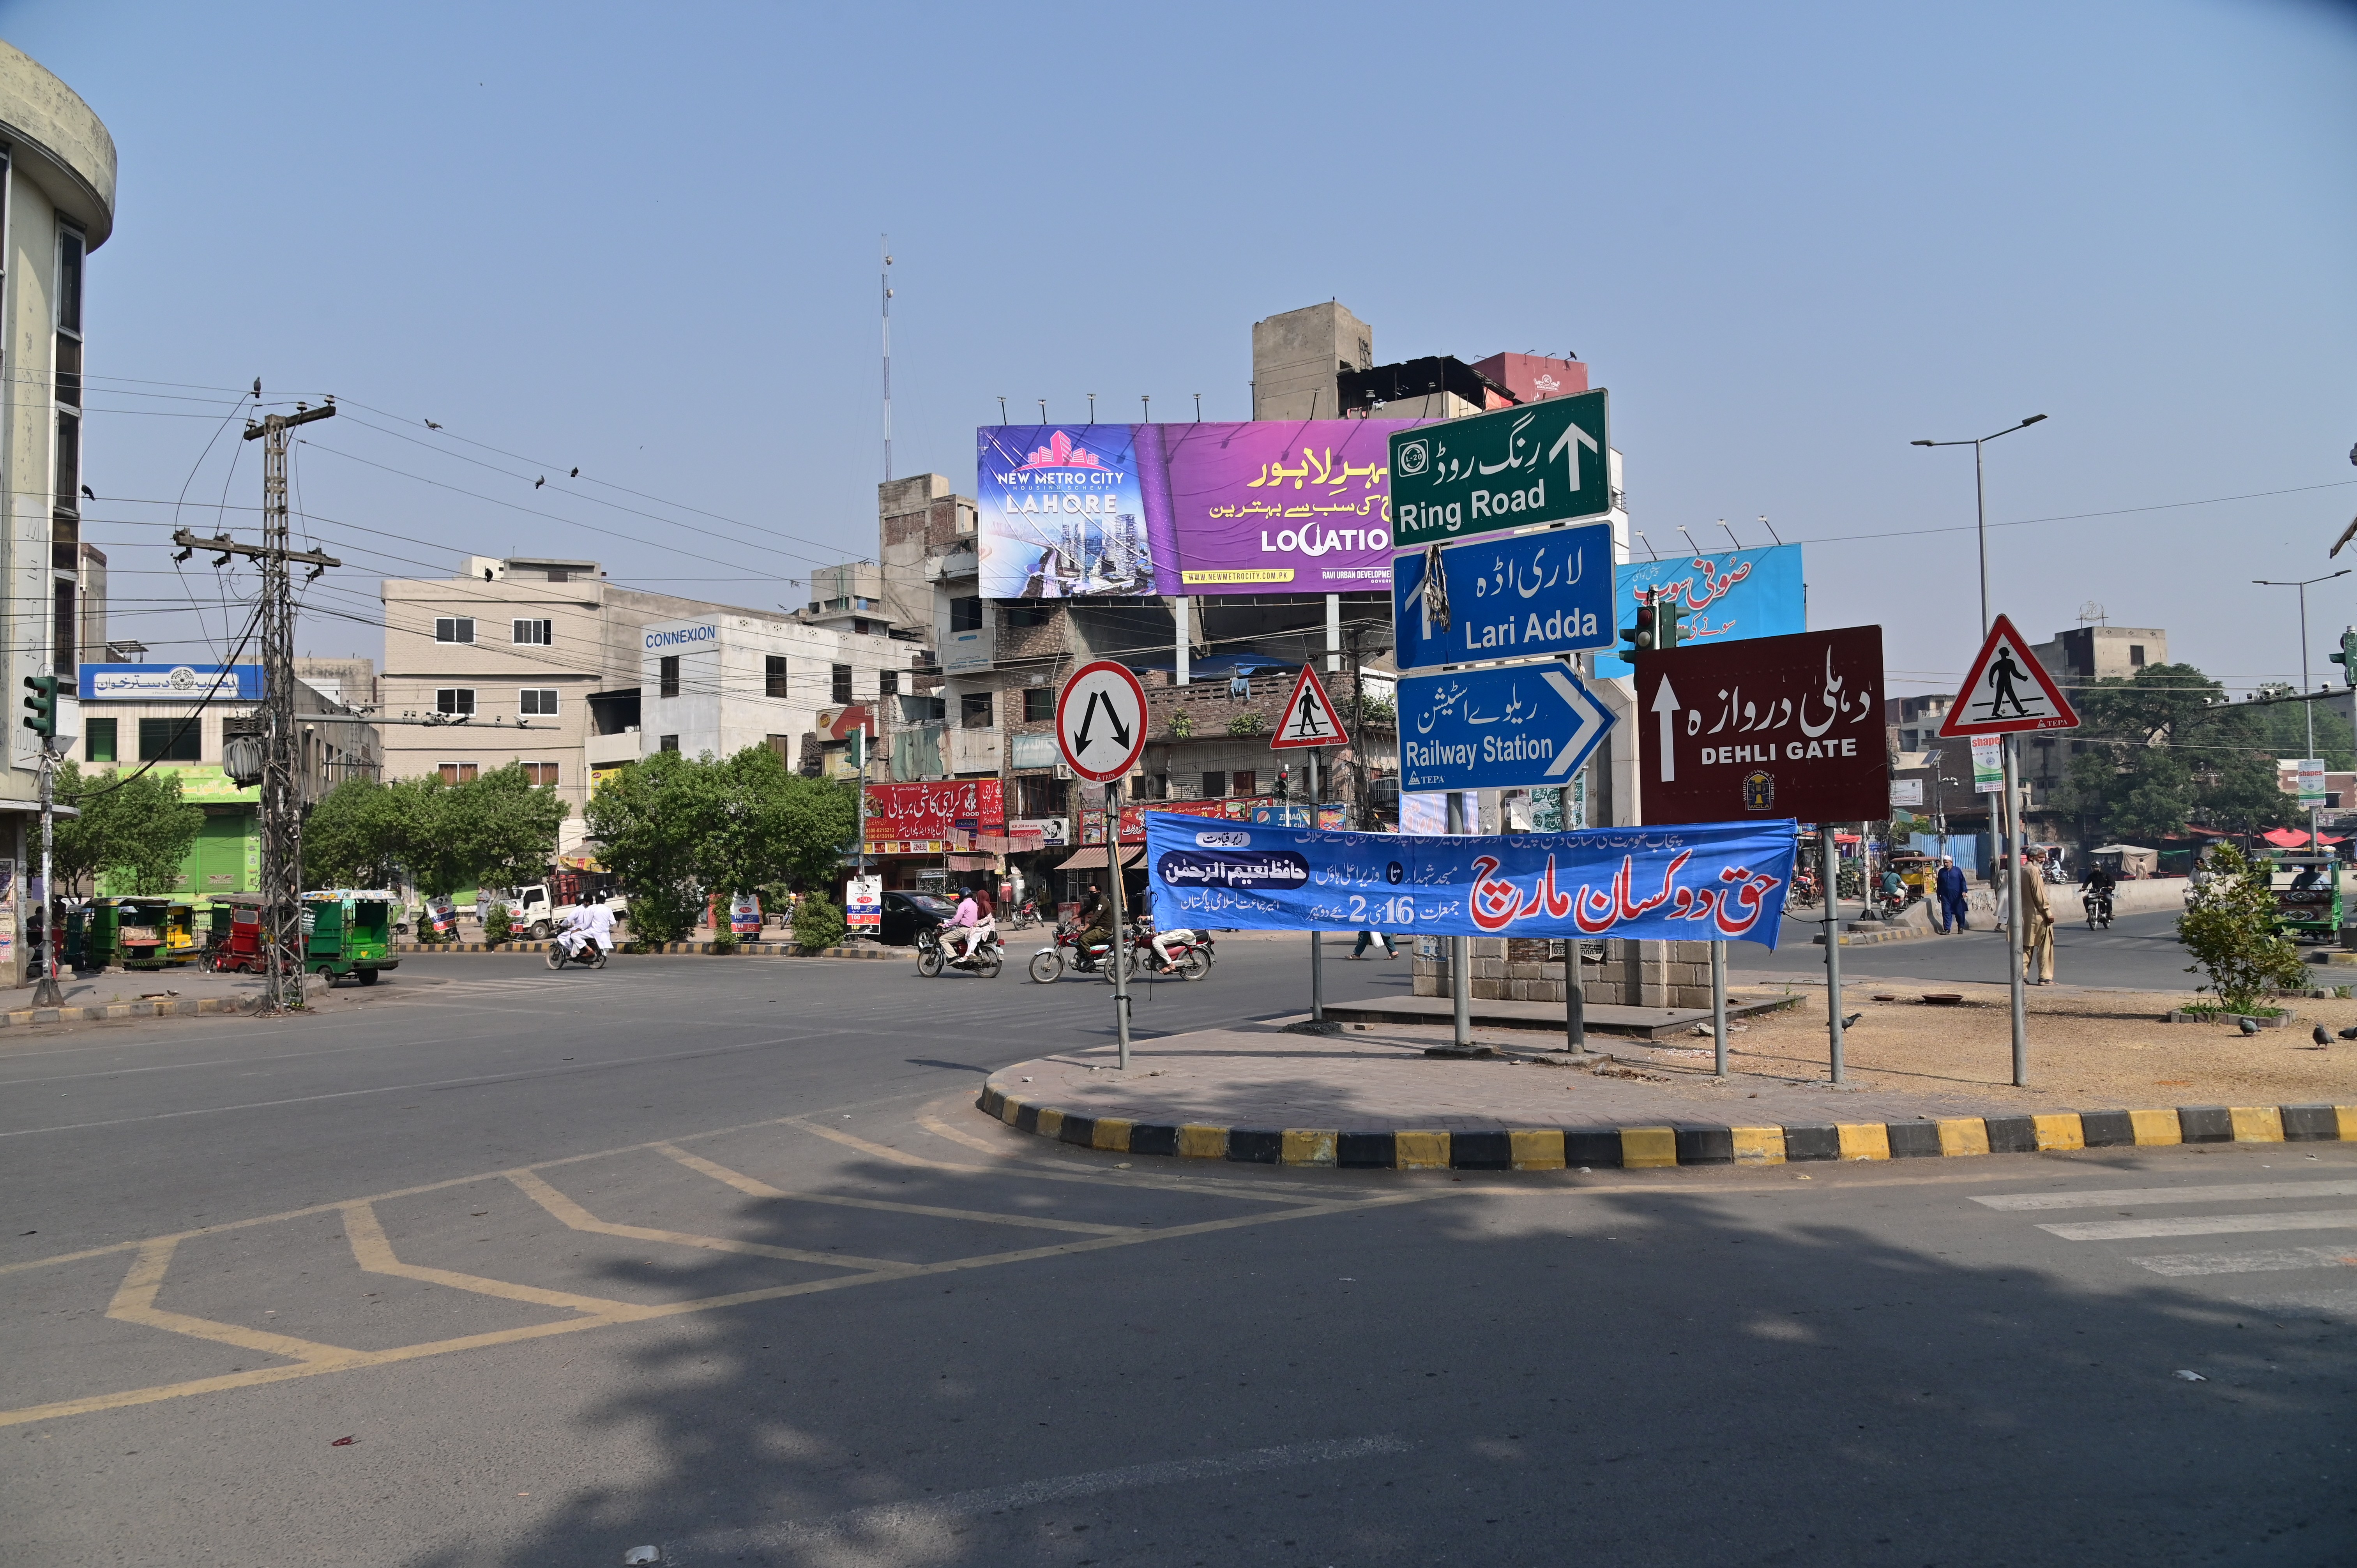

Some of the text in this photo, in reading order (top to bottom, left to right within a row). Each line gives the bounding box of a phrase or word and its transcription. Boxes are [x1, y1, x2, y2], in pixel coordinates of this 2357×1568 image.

[1246, 447, 1332, 489] لاہور
[1406, 454, 1422, 462] L-20
[1433, 440, 1475, 486] روڈ
[998, 472, 1124, 484] NEW METRO CITY
[1006, 494, 1117, 514] LAHORE
[1209, 500, 1282, 519] بہترین
[1284, 502, 1315, 517] سے
[1312, 502, 1355, 516] سب
[1356, 494, 1381, 516] کی
[1400, 501, 1461, 533] Ring
[1472, 479, 1545, 519] Road
[1188, 571, 1287, 581] WWW.NEWMETROCITY.COM.PK
[1322, 570, 1391, 579] RAVI URBAN DEVELOPME
[1518, 546, 1582, 598] لاری
[646, 625, 715, 648] CONNEXION
[1466, 607, 1598, 649] Lari Adda
[96, 675, 170, 690] دسترخوان
[1417, 680, 1537, 734] ریلوے اسٹیشن
[1406, 733, 1553, 770] Railway Station
[1701, 738, 1857, 765] DEHLI GATE
[1421, 775, 1445, 784] TEPA
[1754, 769, 1770, 777] LAHORE
[888, 786, 913, 819] بریانی
[982, 781, 997, 802] کراچی
[936, 784, 968, 823] کراچی
[965, 799, 977, 812] KK
[1203, 832, 1230, 846] قیادت
[1228, 859, 1269, 886] نعیم
[1269, 859, 1307, 879] حافظ
[1391, 864, 1401, 882] تا
[1434, 866, 1458, 885] مسجد
[1180, 888, 1279, 914] امیر جماعت اسلامی پاکستان
[1469, 848, 1781, 936] حق دو کسان مارچ
[1349, 895, 1367, 922] 2
[1383, 897, 1414, 924] 16
[1419, 901, 1459, 923] جمعرات
